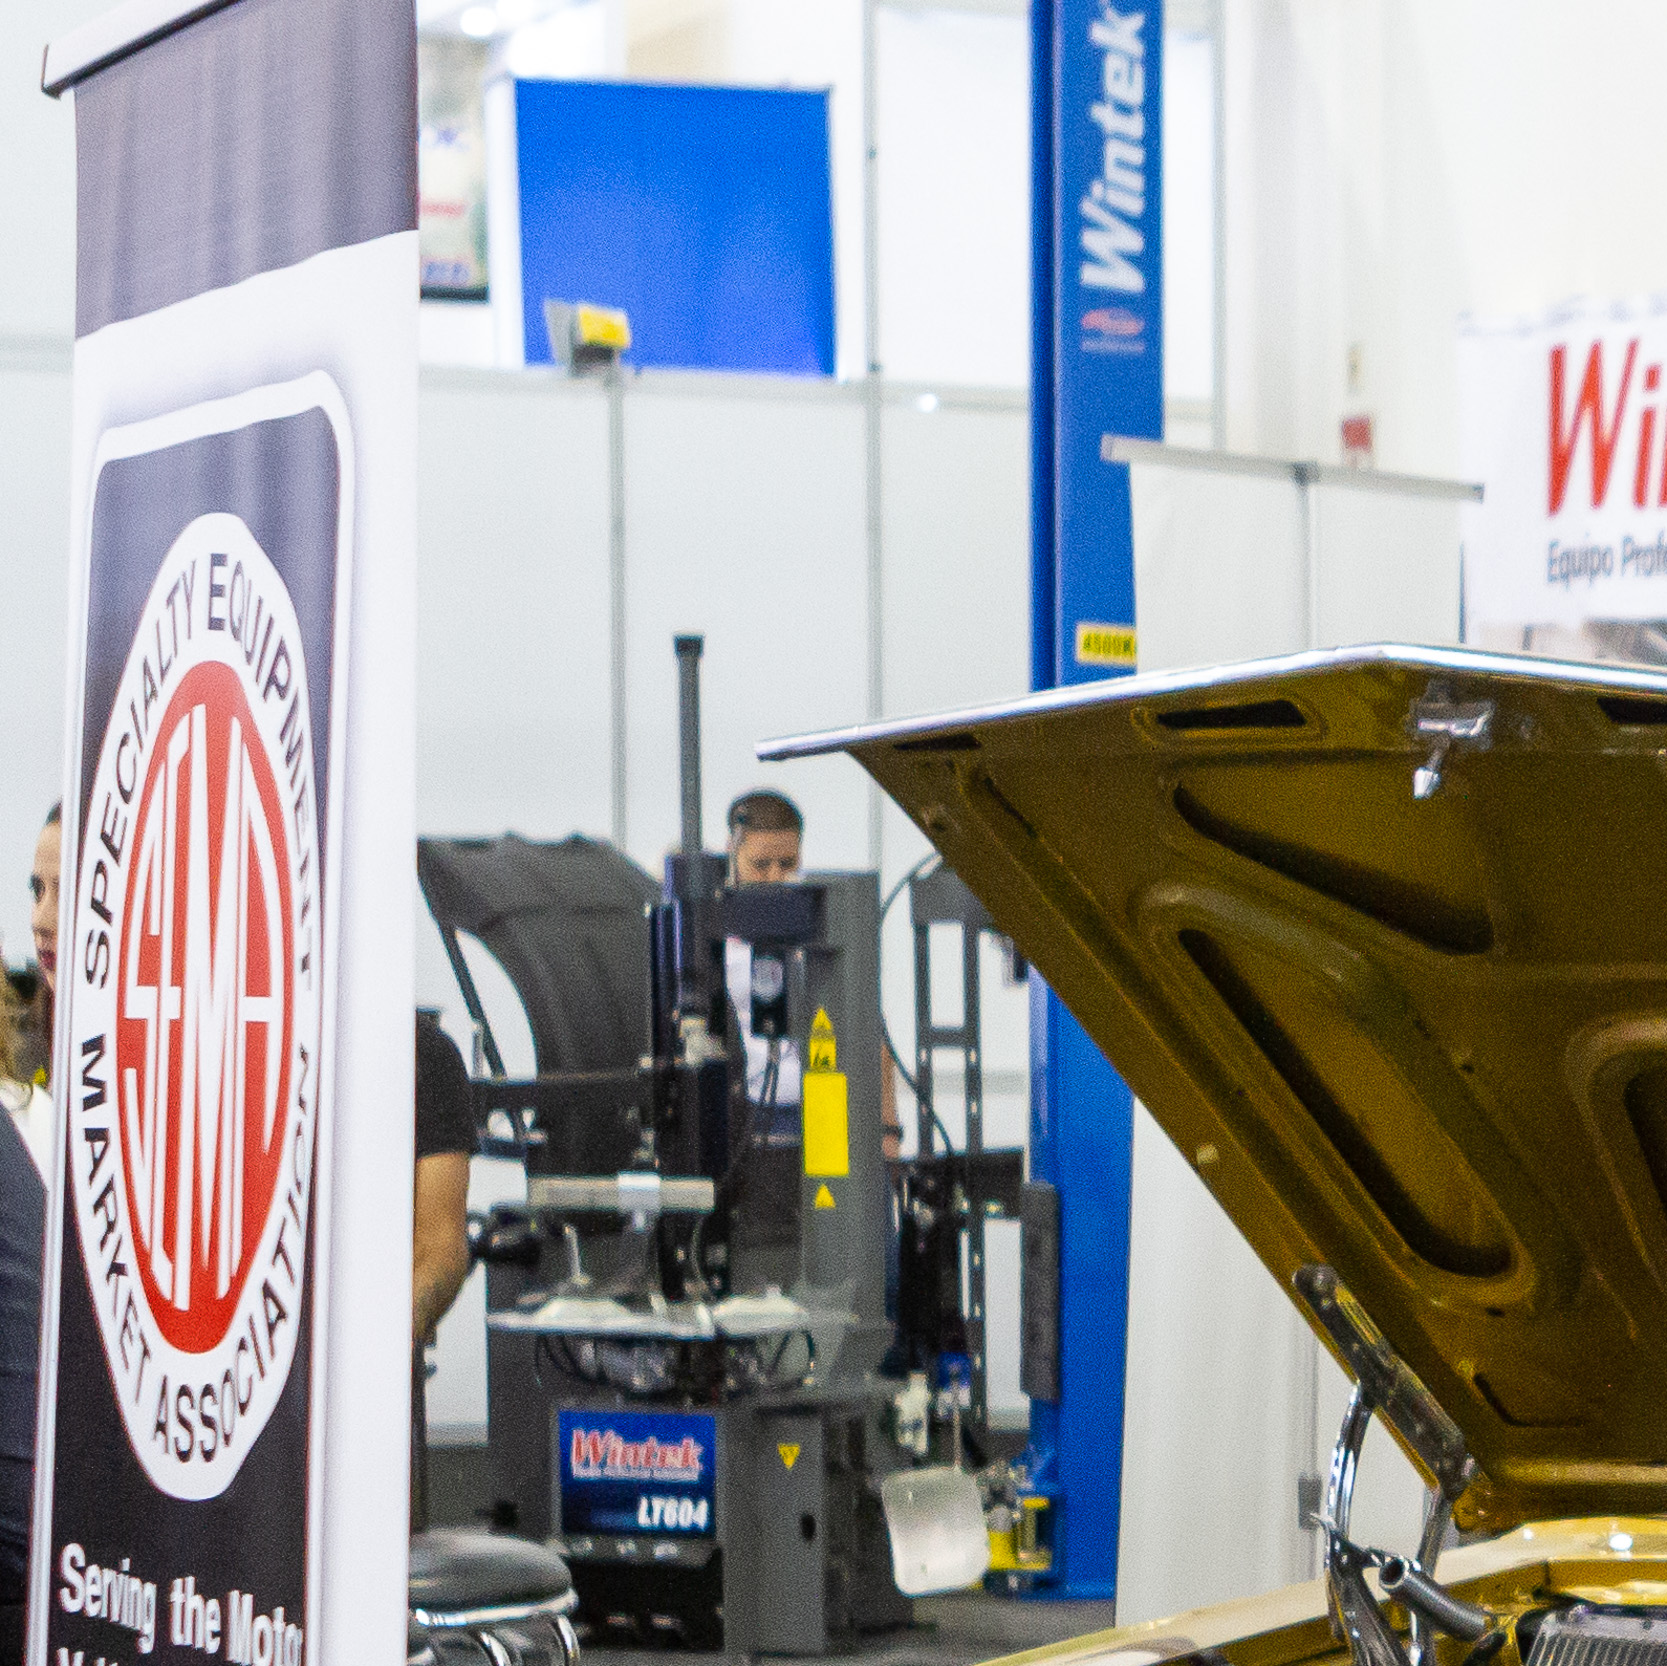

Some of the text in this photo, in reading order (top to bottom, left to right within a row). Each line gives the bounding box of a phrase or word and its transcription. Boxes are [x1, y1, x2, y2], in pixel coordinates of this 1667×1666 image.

[1080, 8, 1146, 293] Wintek
[1547, 537, 1613, 589] Equipo
[84, 560, 197, 990] SPECIALTY
[122, 702, 284, 1312] SEMA
[80, 1034, 152, 1404] MARKET
[572, 1429, 703, 1470] Wintek
[59, 1542, 157, 1654] Serving
[170, 1576, 221, 1654] the
